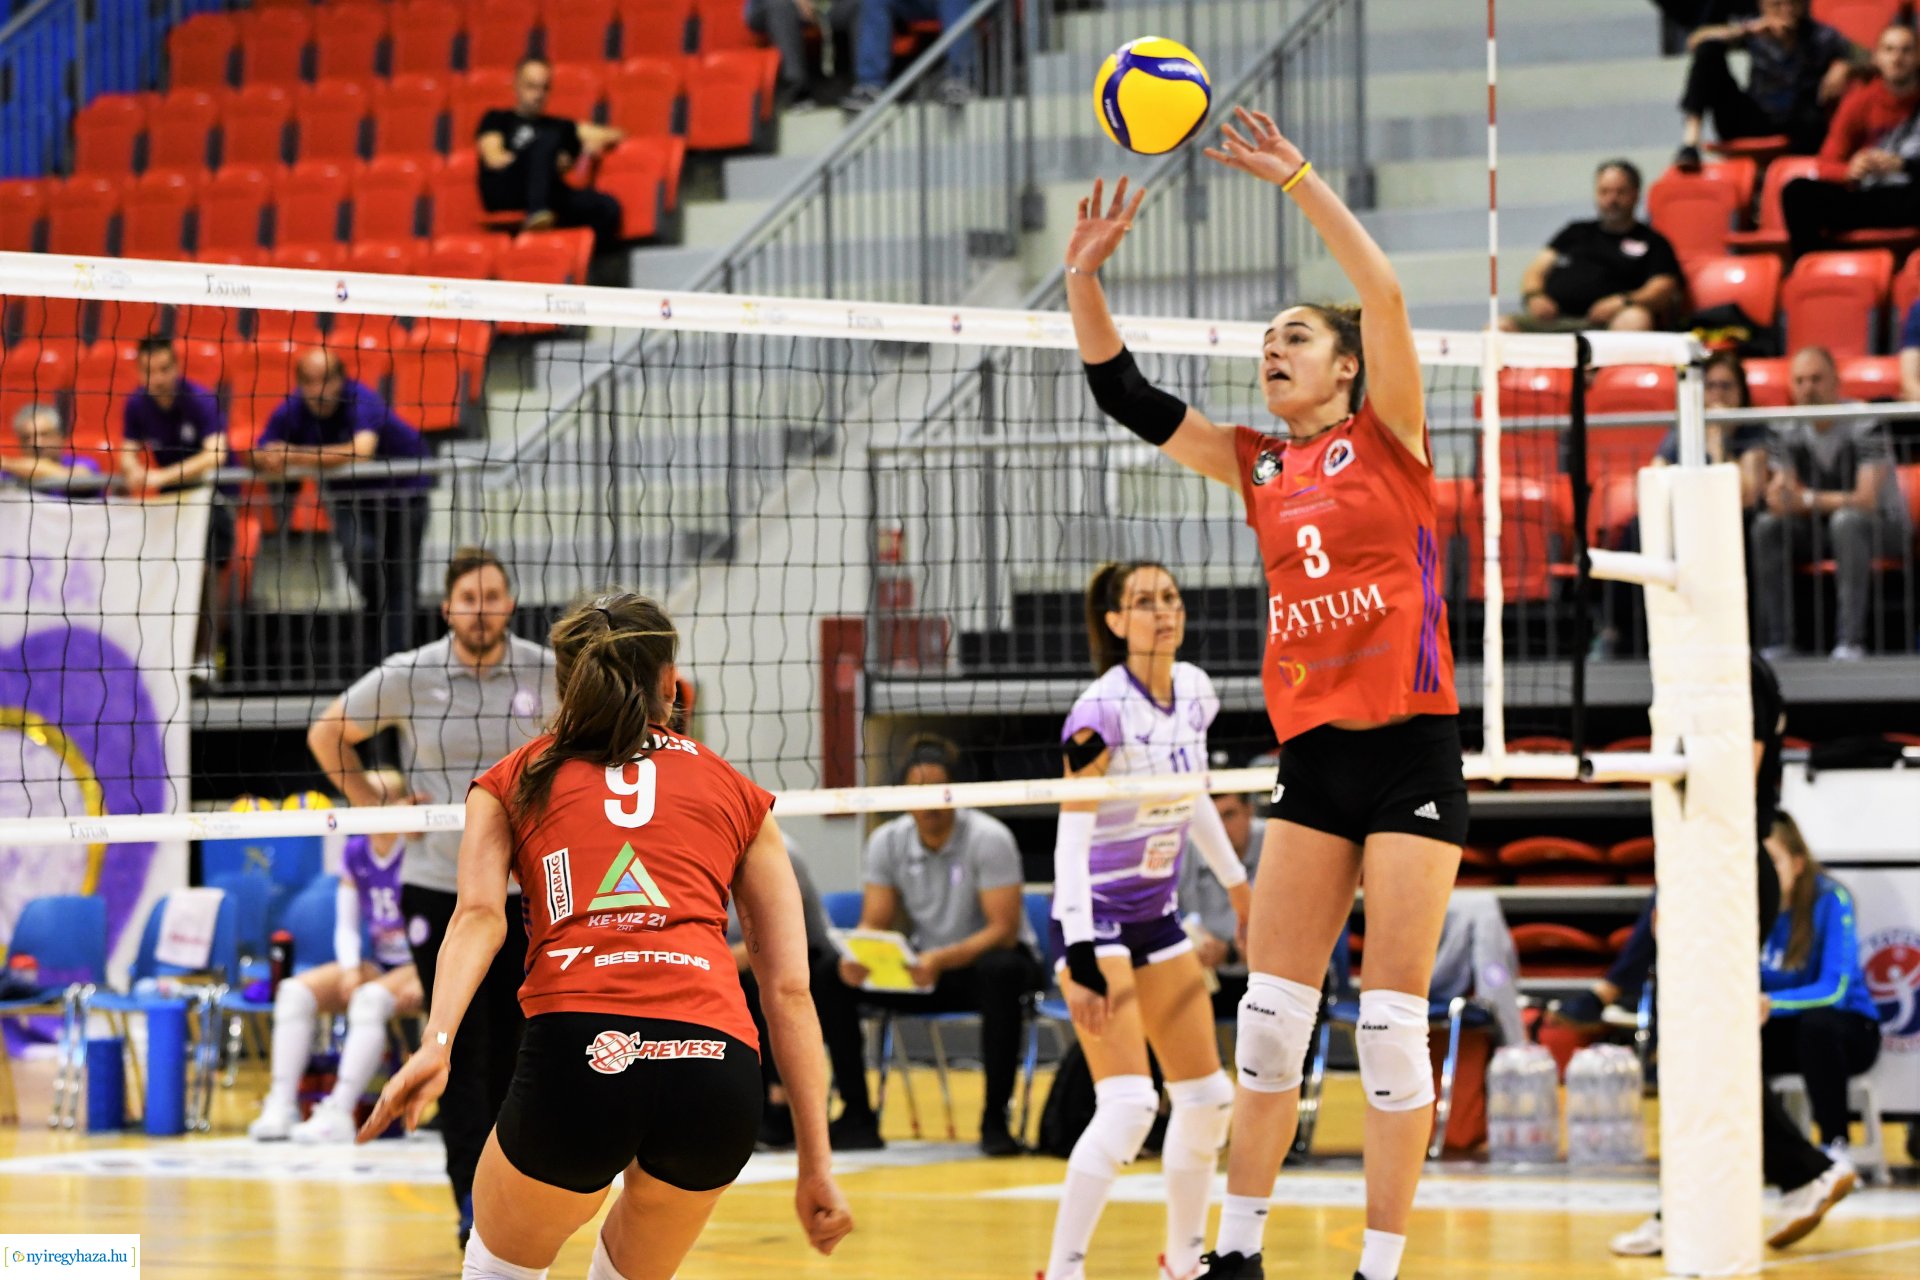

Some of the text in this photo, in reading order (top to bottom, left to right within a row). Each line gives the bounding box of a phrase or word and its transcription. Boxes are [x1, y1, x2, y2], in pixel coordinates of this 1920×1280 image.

[1297, 524, 1331, 579] 3
[1268, 584, 1387, 635] FATUM
[1169, 747, 1190, 773] 11
[604, 752, 657, 829] 9
[551, 855, 567, 918] STRABAG
[587, 912, 667, 928] KE-VIZ 21
[594, 950, 711, 971] BESTRONG
[638, 1040, 726, 1058] REVESZ
